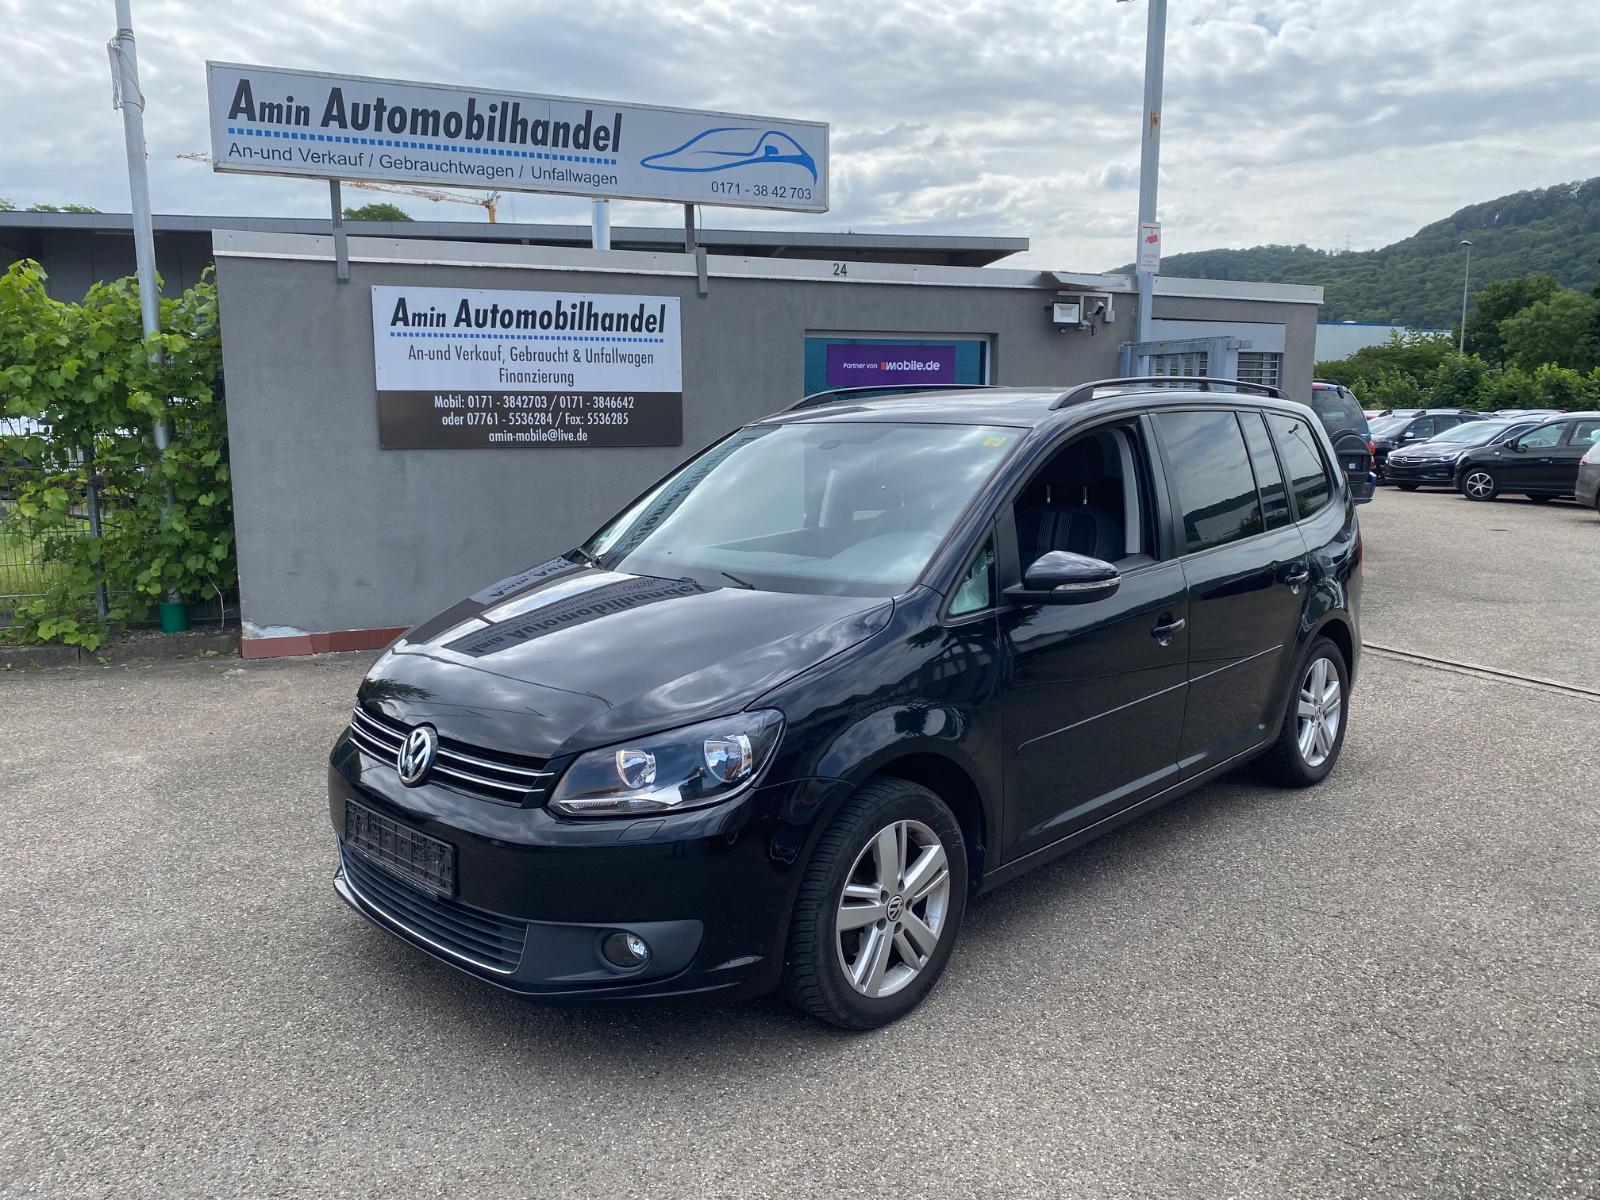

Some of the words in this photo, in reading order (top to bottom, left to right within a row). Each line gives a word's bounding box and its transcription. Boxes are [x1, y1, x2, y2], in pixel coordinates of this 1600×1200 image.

[228, 79, 310, 126] Amin
[320, 87, 622, 153] Automobilhandel
[229, 142, 292, 160] An-und
[298, 148, 364, 166] Verkauf
[369, 153, 373, 167] /
[380, 154, 513, 180] Gebrauchtwagen
[519, 165, 523, 178] /
[532, 166, 617, 187] Unfallwagen
[712, 181, 739, 194] 0171
[754, 185, 768, 196] 38
[772, 186, 786, 198] 42
[790, 187, 811, 200] 703
[833, 263, 848, 277] 24
[391, 298, 446, 327] Amin
[454, 299, 665, 332] Automobilhandel
[409, 344, 450, 360] An-und
[455, 344, 505, 364] Verkauf,
[510, 346, 568, 362] Gebraucht
[573, 349, 581, 362] &
[586, 347, 653, 367] Unfallwagen
[883, 360, 940, 371] mobile.de
[500, 368, 574, 387] Finanzierung
[435, 394, 464, 408] Mobil:
[468, 396, 492, 408] 0171
[503, 396, 547, 408] 3842703
[550, 395, 557, 411] /
[560, 396, 582, 408] 0171
[593, 396, 634, 408] 3846642
[442, 412, 464, 425] oder
[468, 413, 498, 425] 07761
[509, 413, 552, 424] 5536284
[555, 412, 563, 428] /
[566, 413, 584, 424] Fax:
[588, 413, 628, 424] 5536285
[489, 428, 587, 441] amin-mobile@live.de
